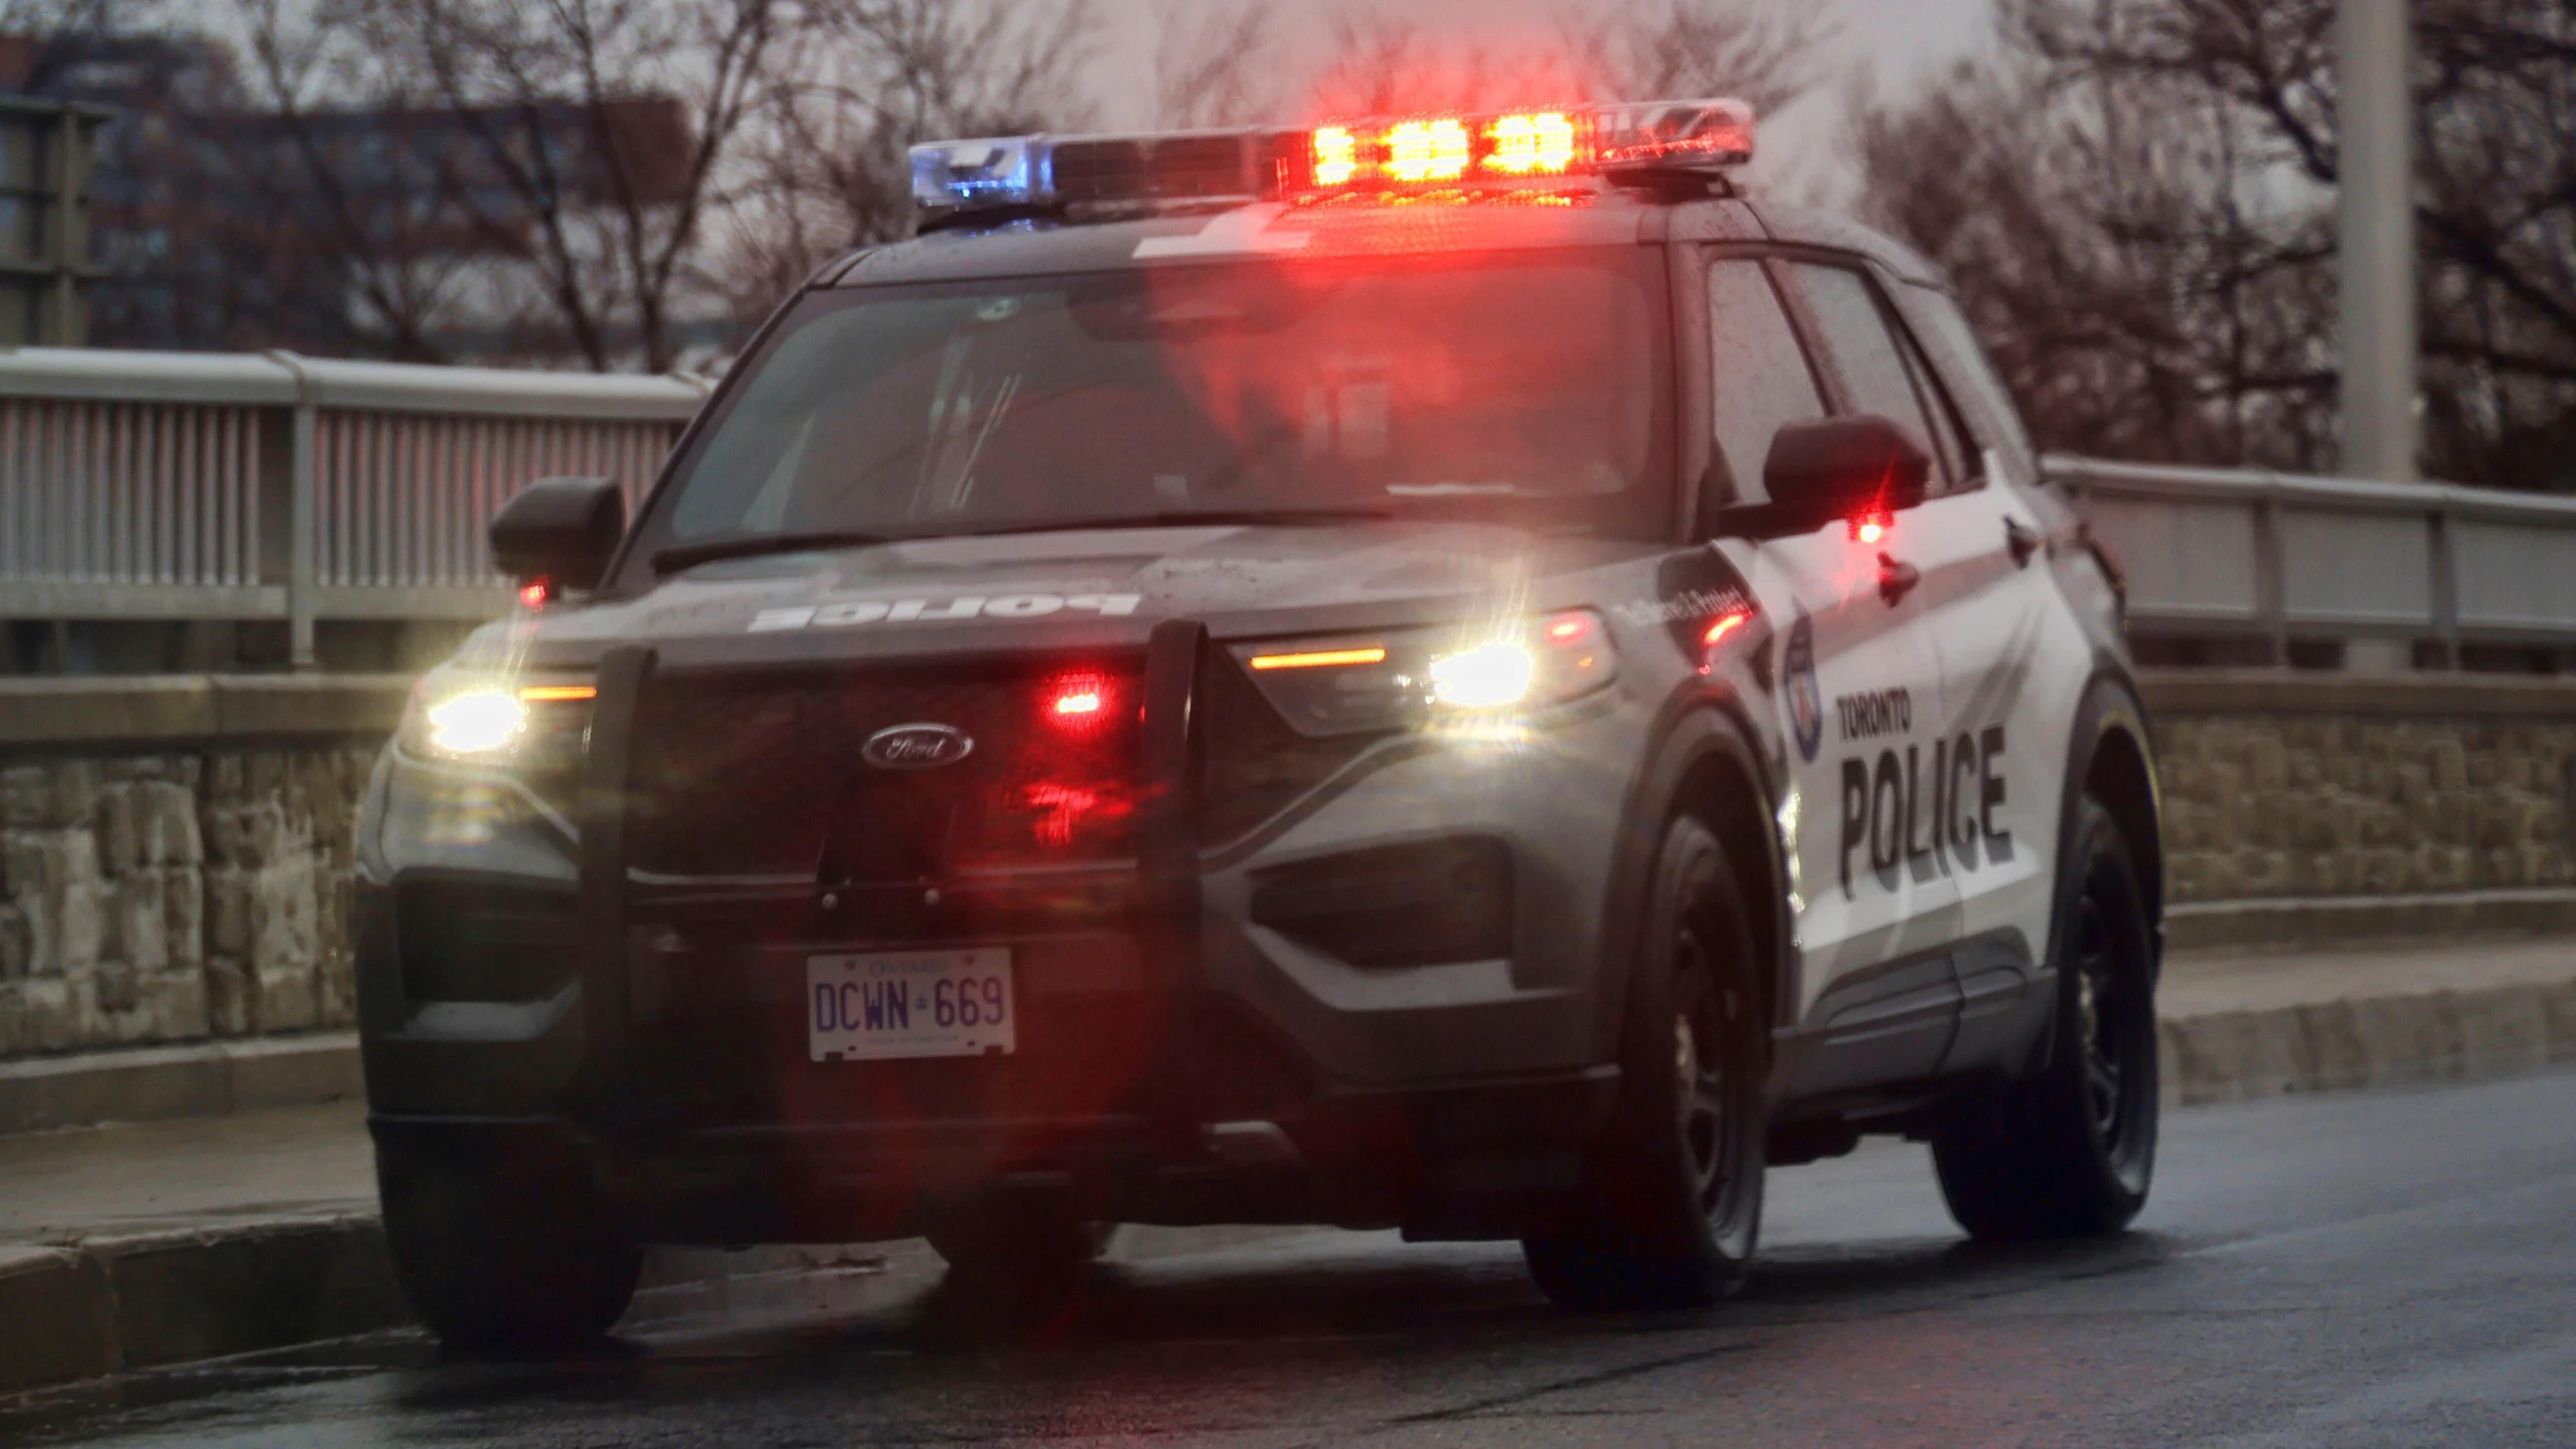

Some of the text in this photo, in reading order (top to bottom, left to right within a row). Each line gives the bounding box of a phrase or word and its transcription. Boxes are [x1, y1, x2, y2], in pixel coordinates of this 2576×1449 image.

[1837, 686, 1911, 740] TORONTO
[885, 736, 946, 760] Ford
[1841, 722, 2015, 901] POLICE
[815, 977, 1003, 1032] DCWN 669
